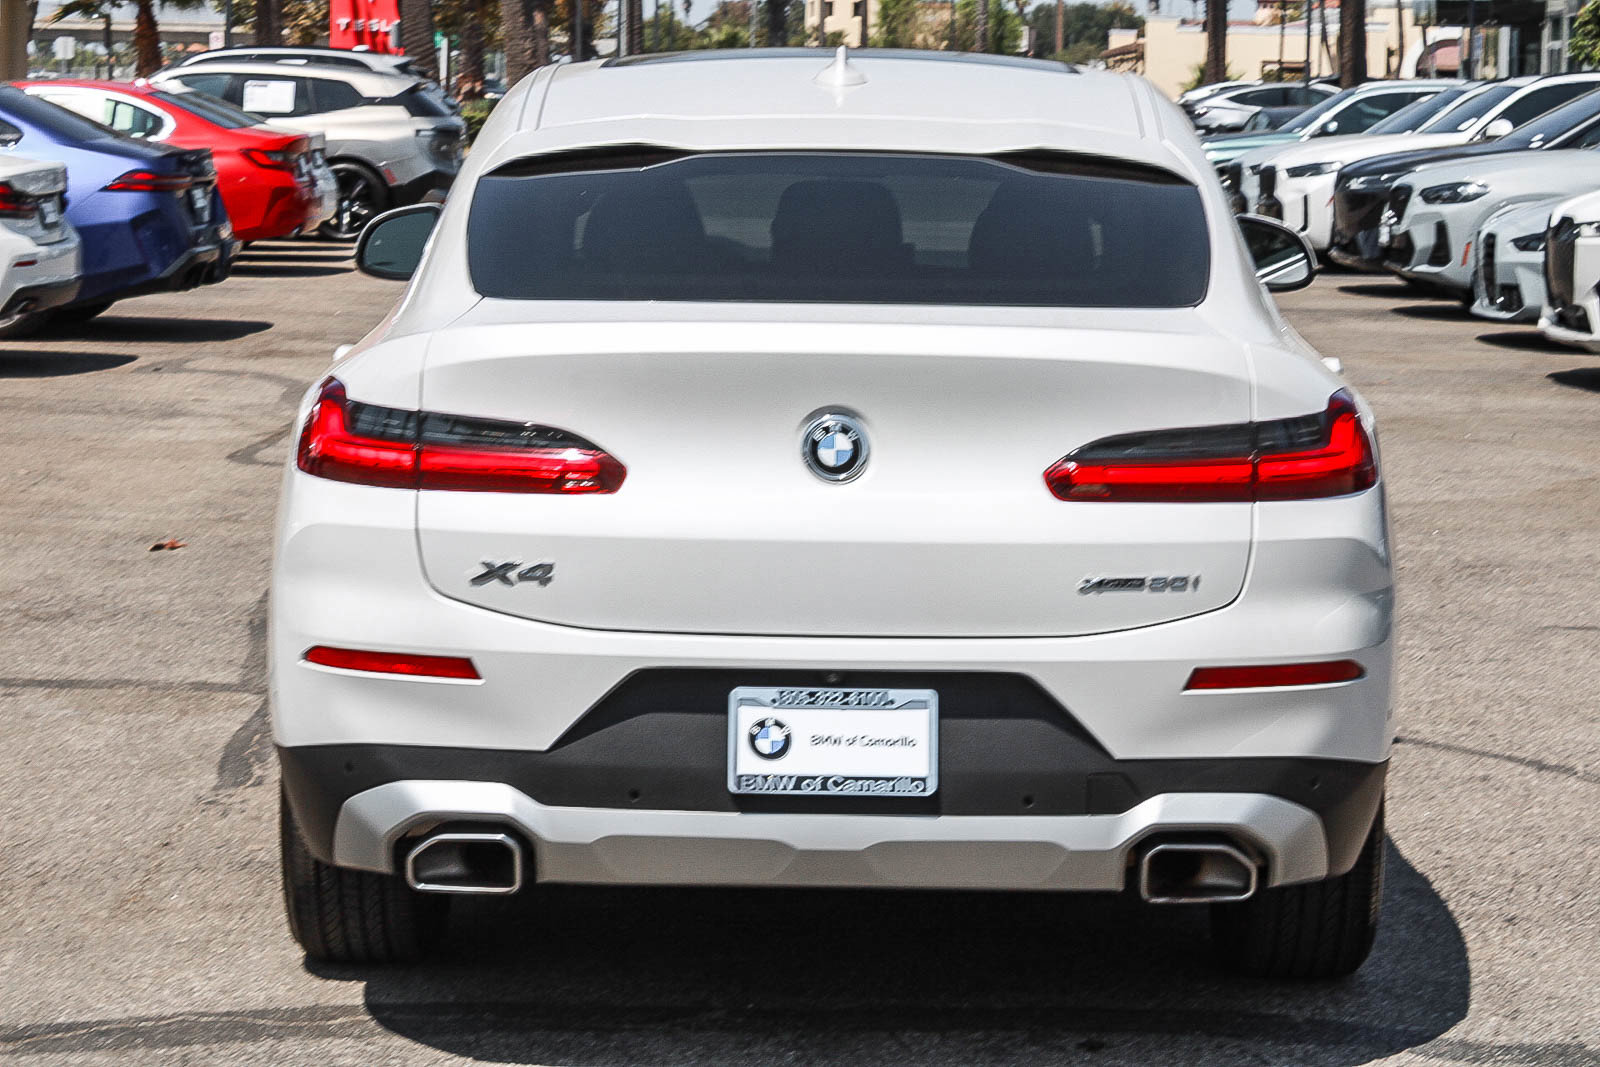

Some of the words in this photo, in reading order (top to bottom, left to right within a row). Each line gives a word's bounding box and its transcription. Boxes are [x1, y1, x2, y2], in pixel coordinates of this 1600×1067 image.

[470, 559, 555, 587] X4
[810, 735, 843, 747] BMW
[845, 735, 858, 747] of
[740, 774, 797, 792] BMW
[801, 775, 825, 792] of
[827, 775, 925, 794] Camarillo
